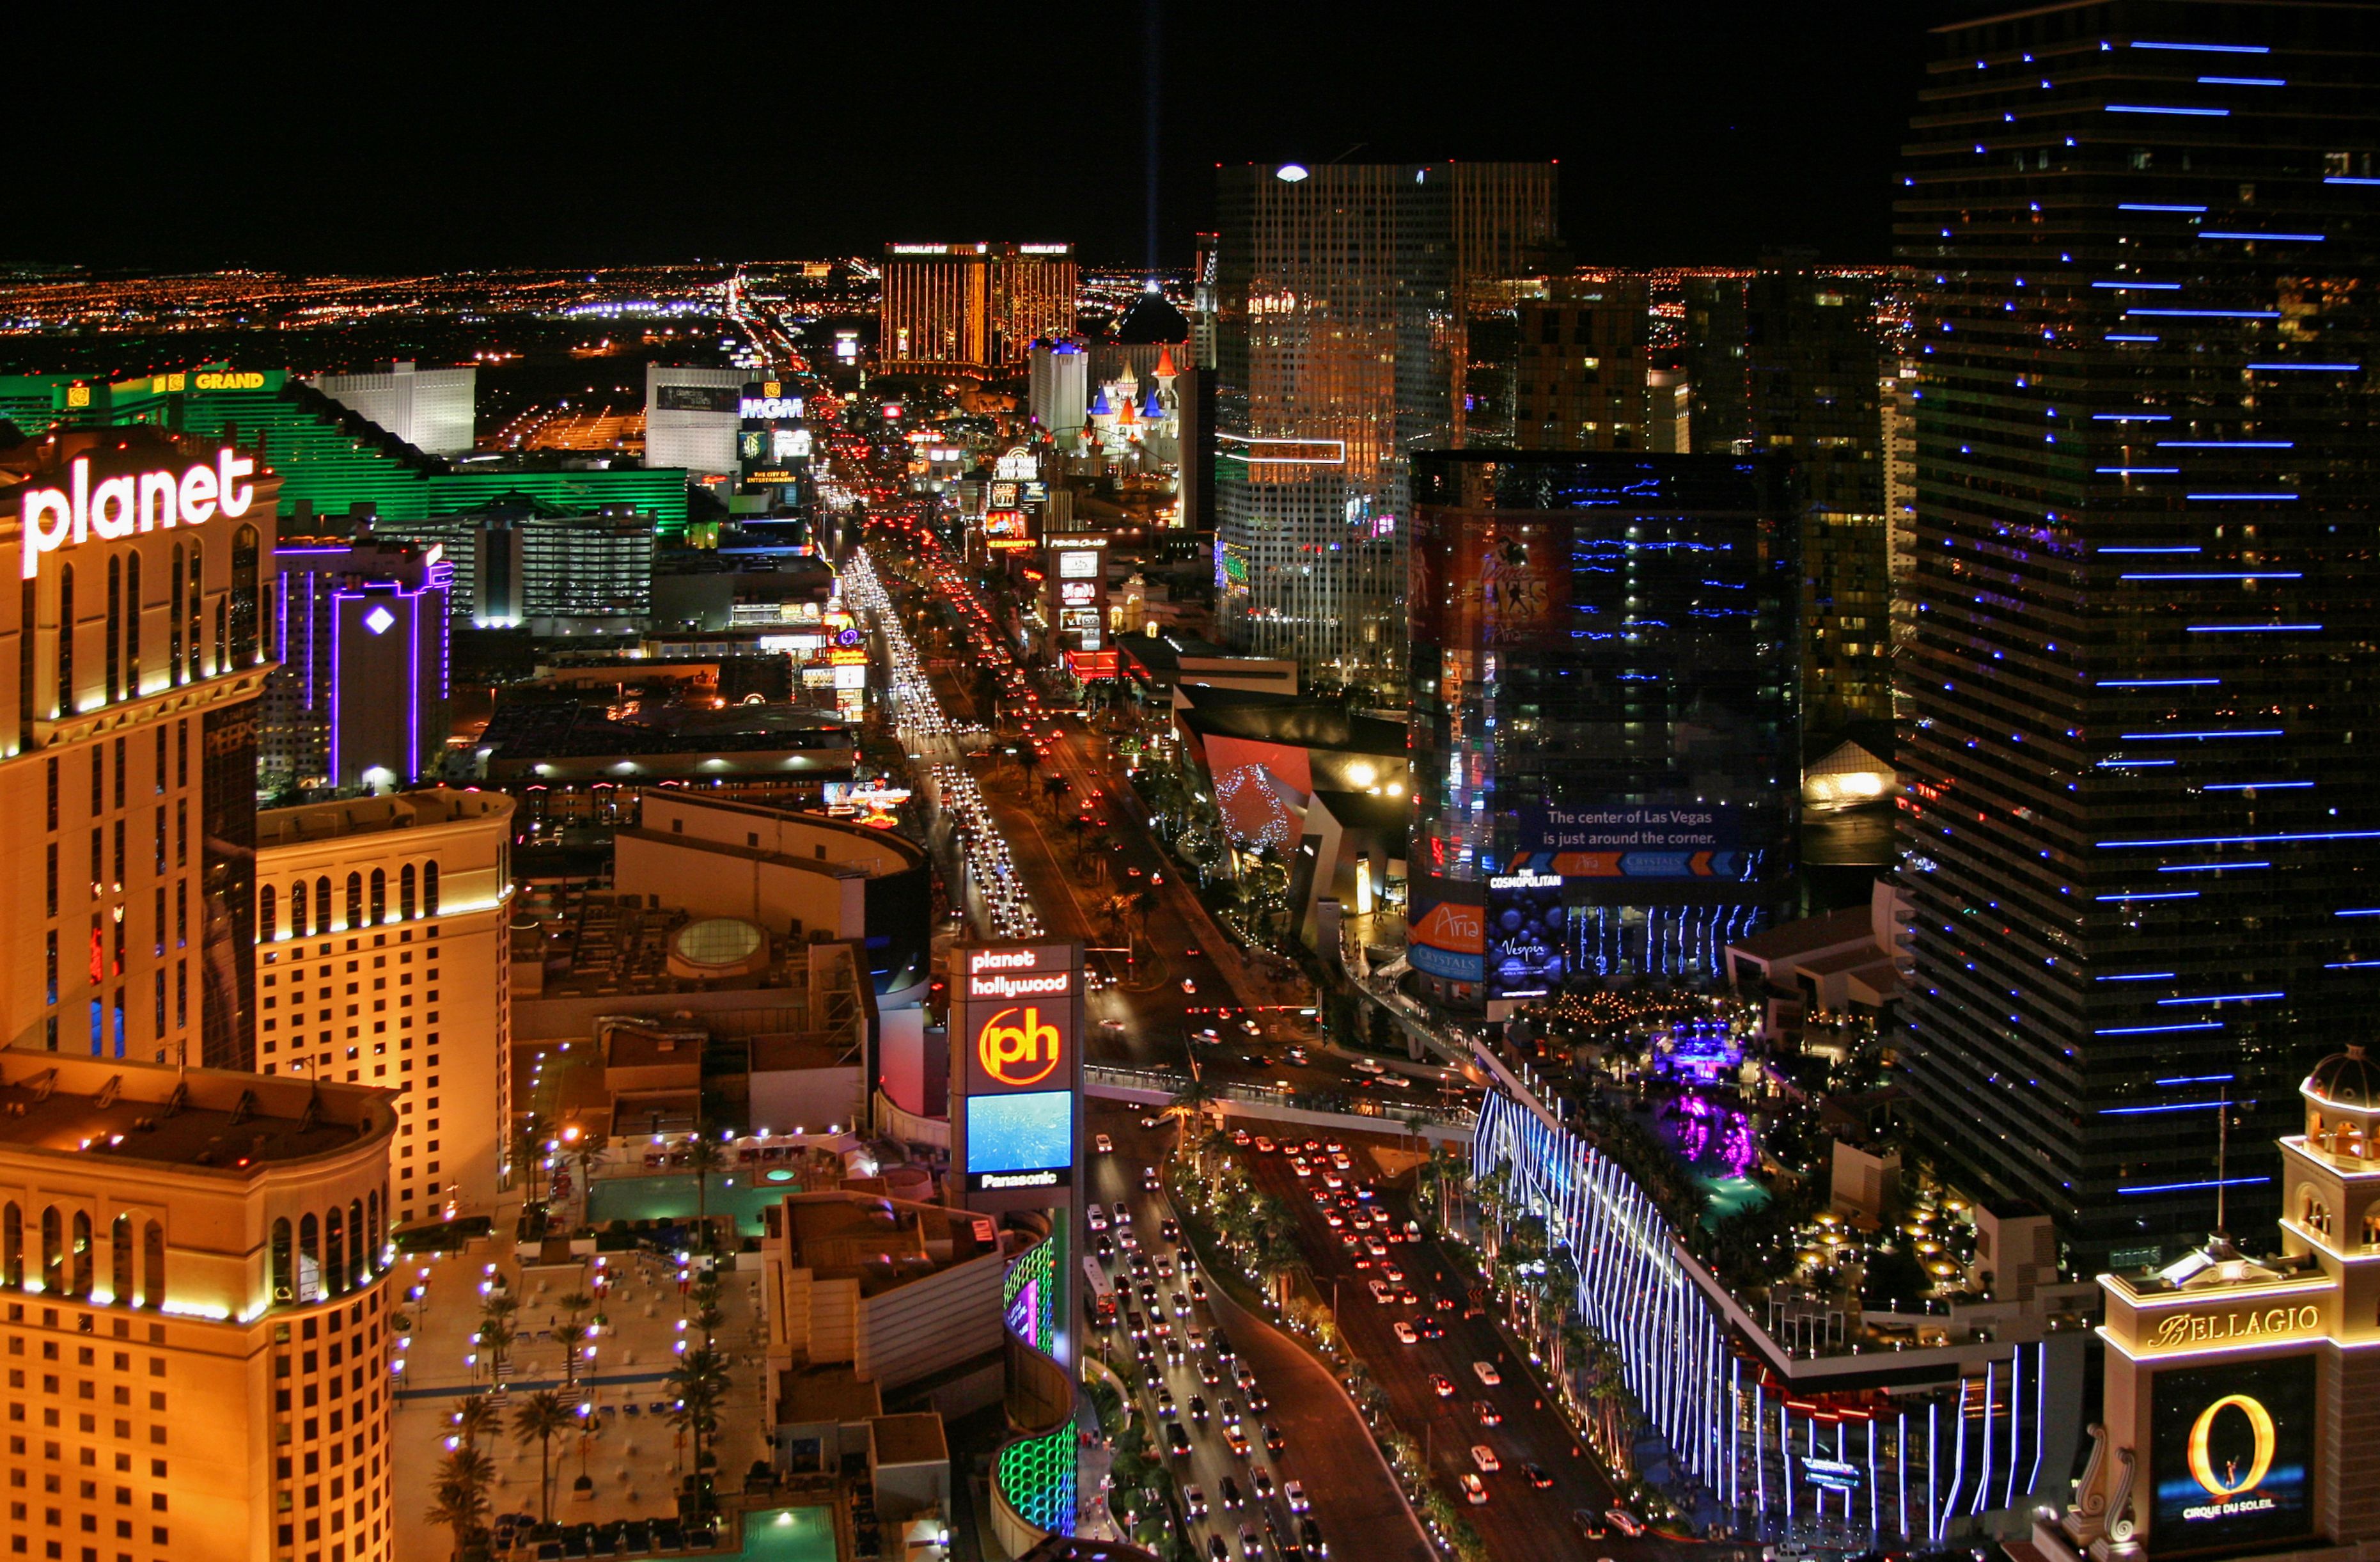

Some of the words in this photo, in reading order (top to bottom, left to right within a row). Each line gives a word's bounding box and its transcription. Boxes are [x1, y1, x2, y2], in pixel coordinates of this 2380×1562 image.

[196, 373, 264, 389] GRAND
[740, 398, 804, 419] MGM
[999, 458, 1016, 468] NEW
[1017, 458, 1037, 468] YORK
[999, 469, 1016, 478] NEW
[1017, 469, 1037, 478] YORK
[22, 449, 254, 580] planet
[1547, 810, 1574, 824] The
[1578, 812, 1622, 824] center
[1626, 810, 1641, 824] of
[1645, 810, 1667, 824] Las
[1670, 810, 1712, 826] Vegas
[1544, 832, 1555, 845] is
[1558, 832, 1585, 848] just
[1588, 832, 1638, 845] around
[1641, 832, 1664, 845] the
[1668, 833, 1716, 845] corner.
[1490, 875, 1562, 888] COSMOPOLITAN
[1518, 869, 1534, 877] THE
[1435, 906, 1479, 937] Aria
[1419, 948, 1475, 970] CRYSTALS
[1502, 937, 1545, 962] Vesper
[972, 951, 1035, 974] planet
[972, 974, 1067, 997] hollywood
[989, 1007, 1059, 1073] ph
[982, 1171, 1057, 1188] Panasonic
[2147, 1306, 2321, 1348] BELLAGIO
[2188, 1394, 2276, 1495] O
[2183, 1503, 2221, 1519] CIRQUE
[2223, 1503, 2239, 1514] DU
[2240, 1498, 2276, 1511] SOLEIL
